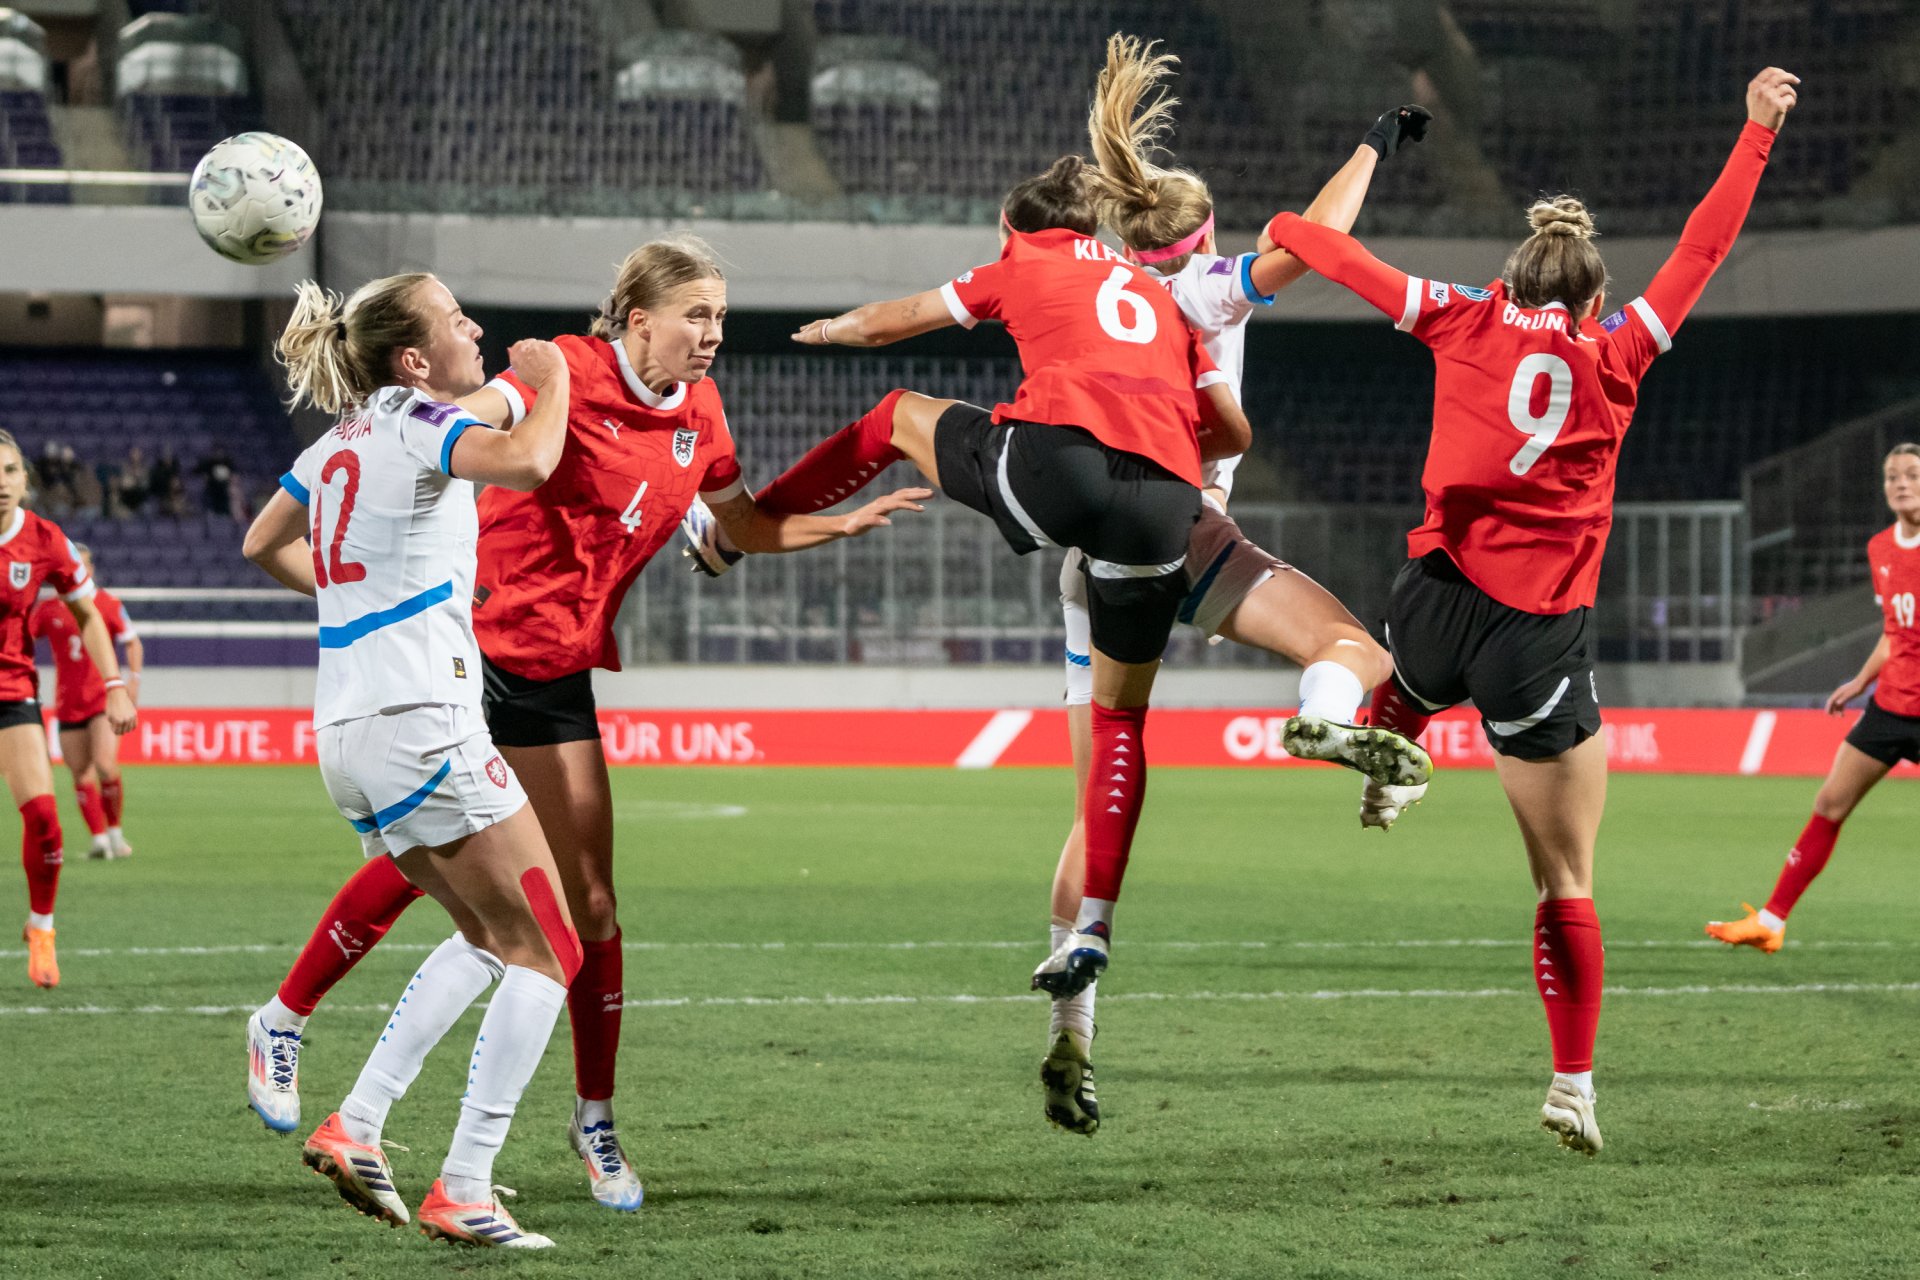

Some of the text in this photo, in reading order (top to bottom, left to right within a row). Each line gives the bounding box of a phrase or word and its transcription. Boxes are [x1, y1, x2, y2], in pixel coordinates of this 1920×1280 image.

[1096, 266, 1158, 344] 6
[1508, 353, 1572, 475] 9
[313, 449, 366, 588] 12
[620, 481, 648, 533] 4
[1891, 592, 1916, 628] 19
[141, 720, 282, 761] HEUTE.
[671, 721, 765, 762] UNS.
